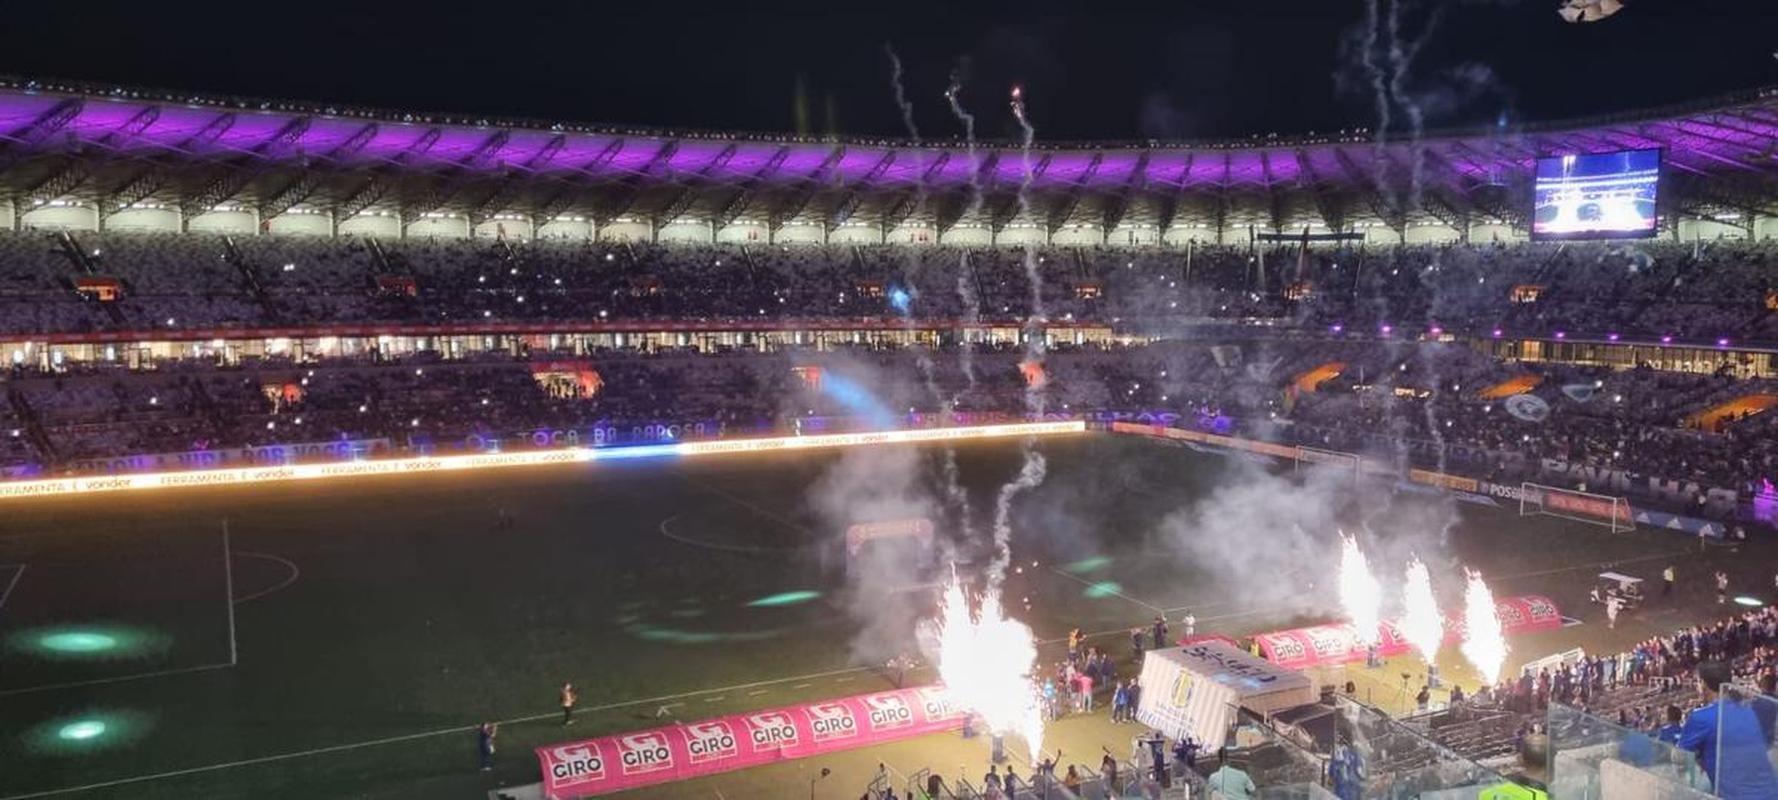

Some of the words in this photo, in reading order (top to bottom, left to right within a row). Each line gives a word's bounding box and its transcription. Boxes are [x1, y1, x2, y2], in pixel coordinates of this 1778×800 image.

[86, 477, 132, 490] vonder
[1273, 643, 1304, 657] GIRO
[813, 715, 854, 734] GIRO
[871, 706, 910, 724] GIRO
[753, 725, 796, 744] GIRO
[689, 735, 735, 755] GIRO
[622, 747, 670, 766] GIRO
[553, 757, 602, 779] GIRO
